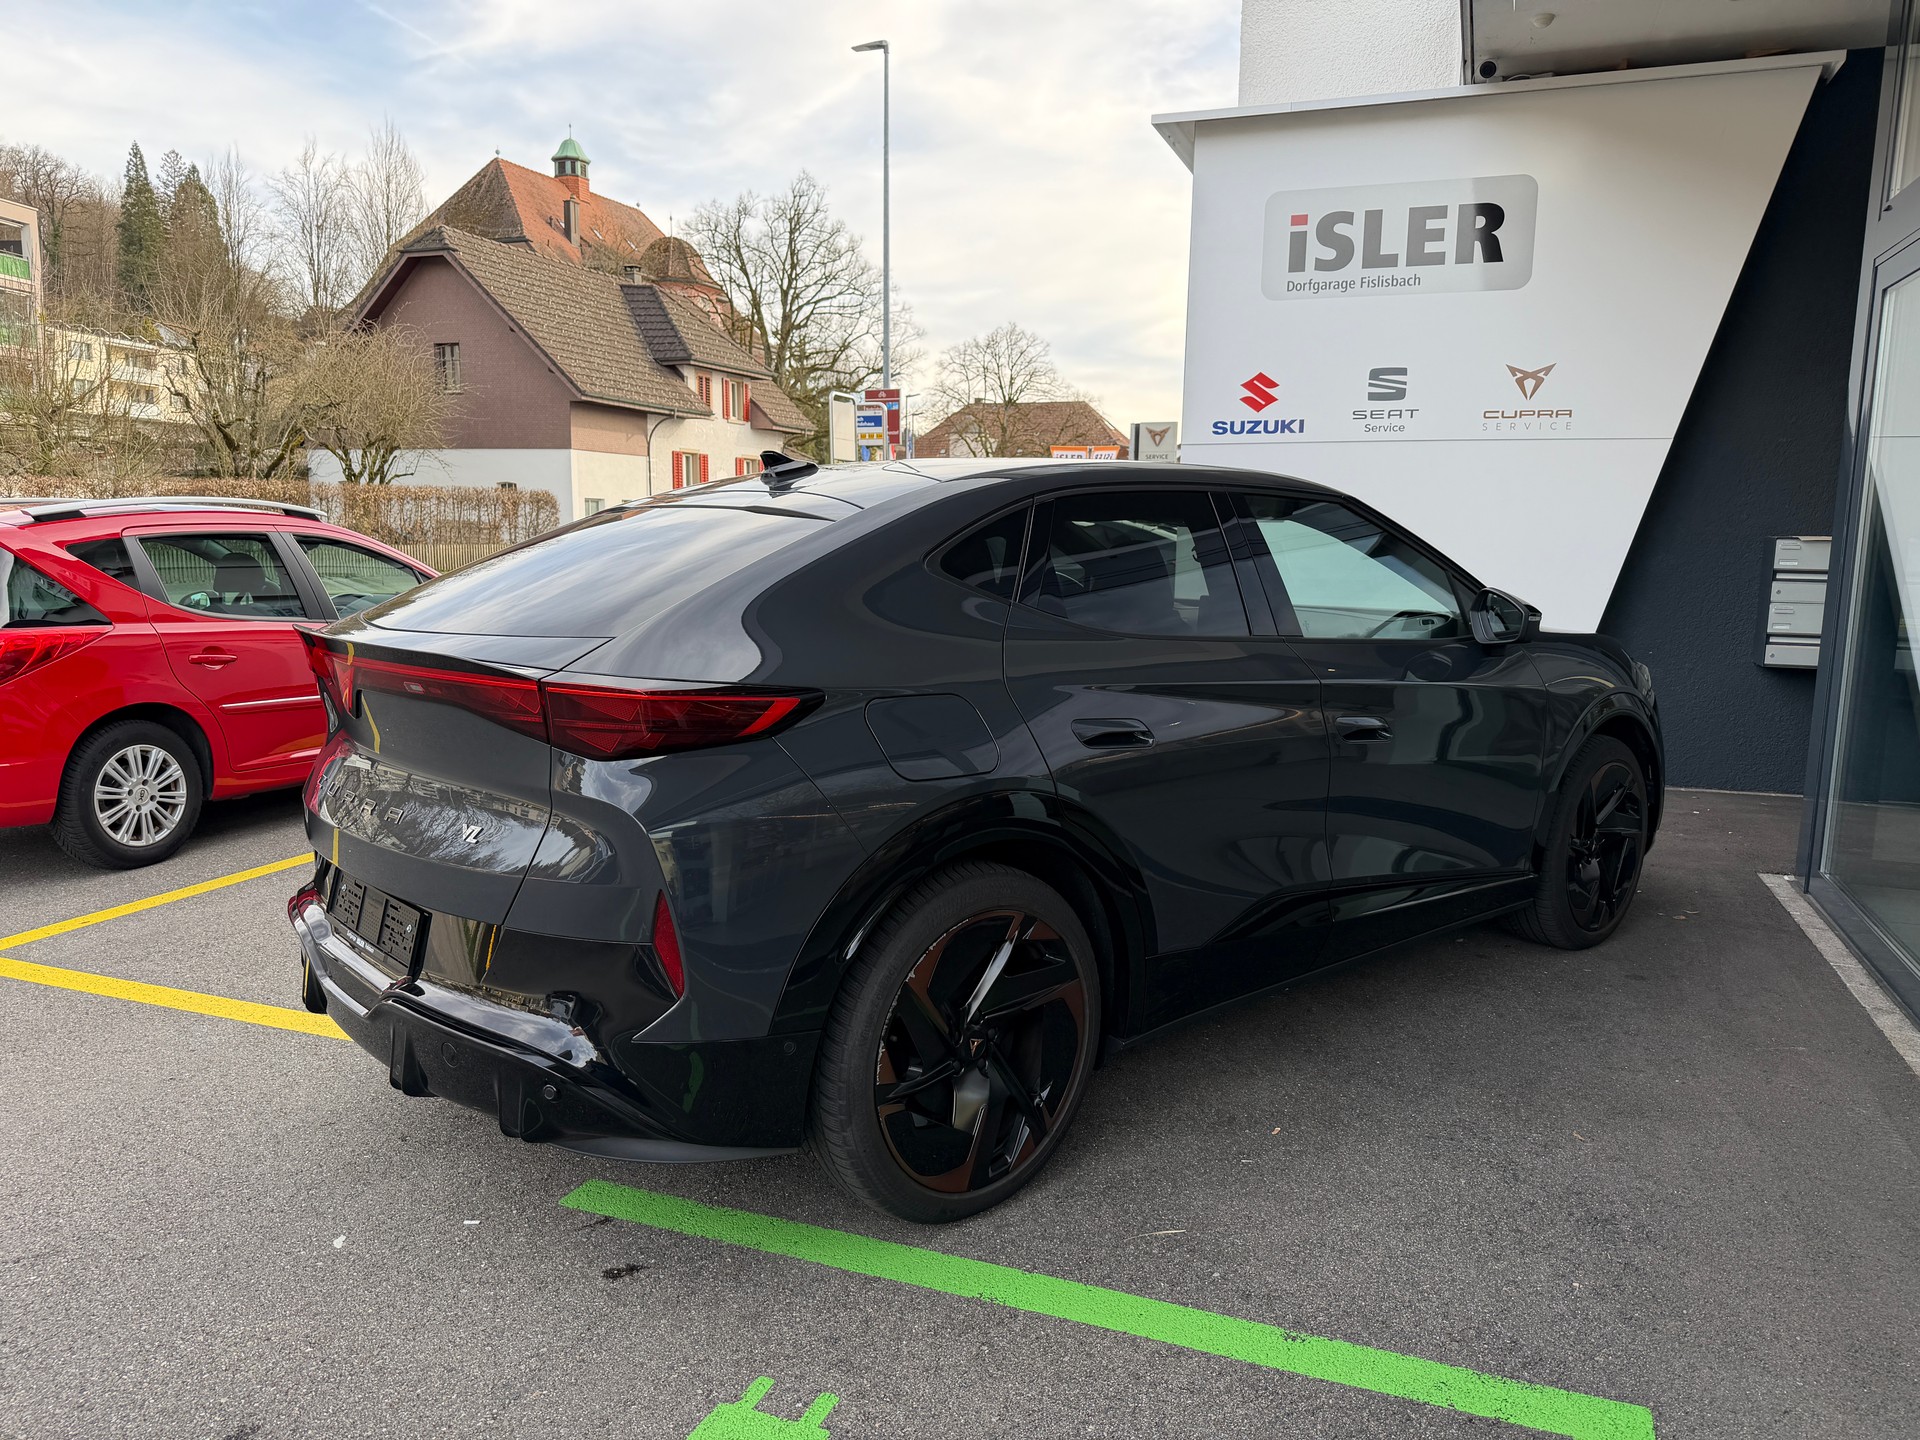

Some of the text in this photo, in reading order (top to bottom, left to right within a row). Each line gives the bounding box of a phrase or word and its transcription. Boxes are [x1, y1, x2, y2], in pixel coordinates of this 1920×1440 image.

[1286, 274, 1421, 294] Dorfgarage Fislisbach
[1352, 409, 1419, 420] SEAT
[1483, 409, 1573, 419] CUPRA
[1212, 419, 1305, 435] SUZUKI
[1363, 423, 1405, 432] Service
[1482, 422, 1572, 431] SERVICE
[462, 823, 484, 844] VZ
